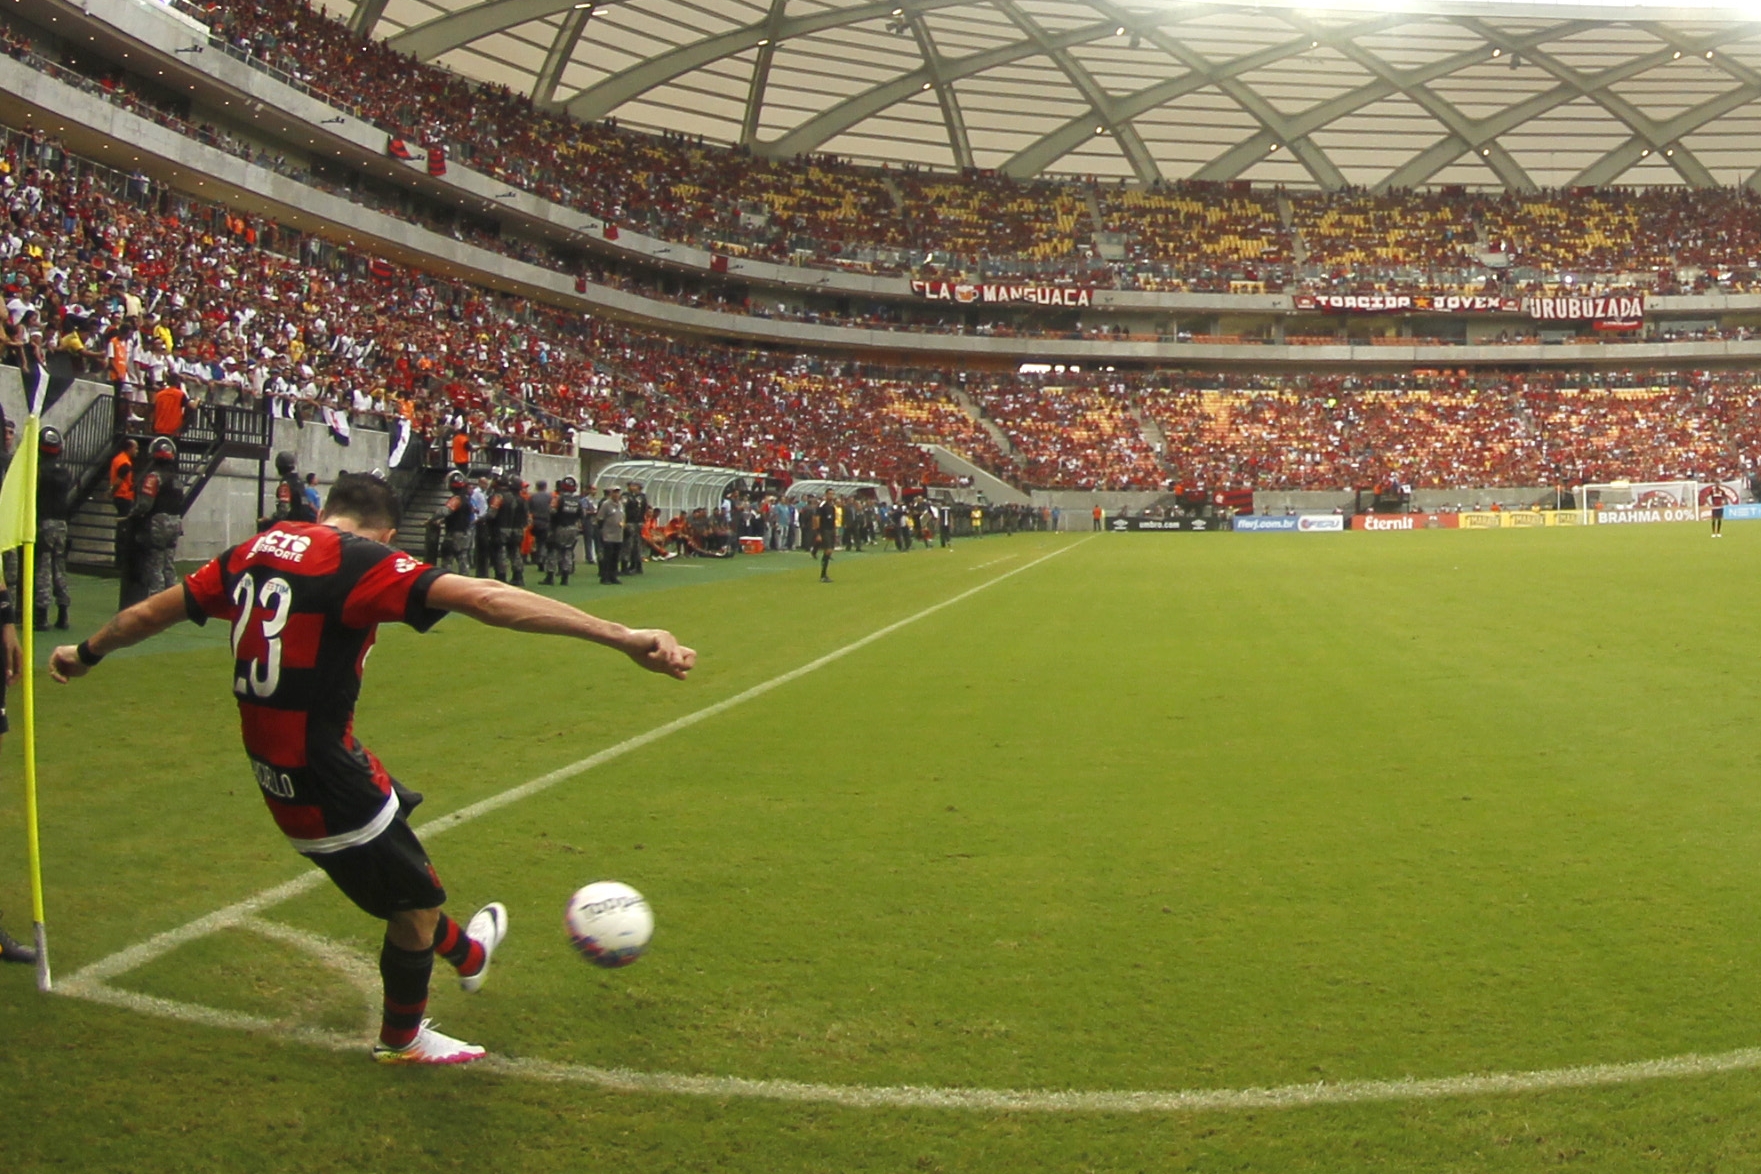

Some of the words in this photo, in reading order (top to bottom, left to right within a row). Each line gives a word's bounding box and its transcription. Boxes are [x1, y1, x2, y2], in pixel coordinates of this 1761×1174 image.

[983, 285, 1089, 306] MANGUACA
[1530, 297, 1643, 318] URUBUZADA
[1139, 520, 1180, 529] umbro.com
[1364, 516, 1413, 530] Eternit
[1598, 511, 1661, 523] BRAHMA
[233, 573, 292, 698] 23
